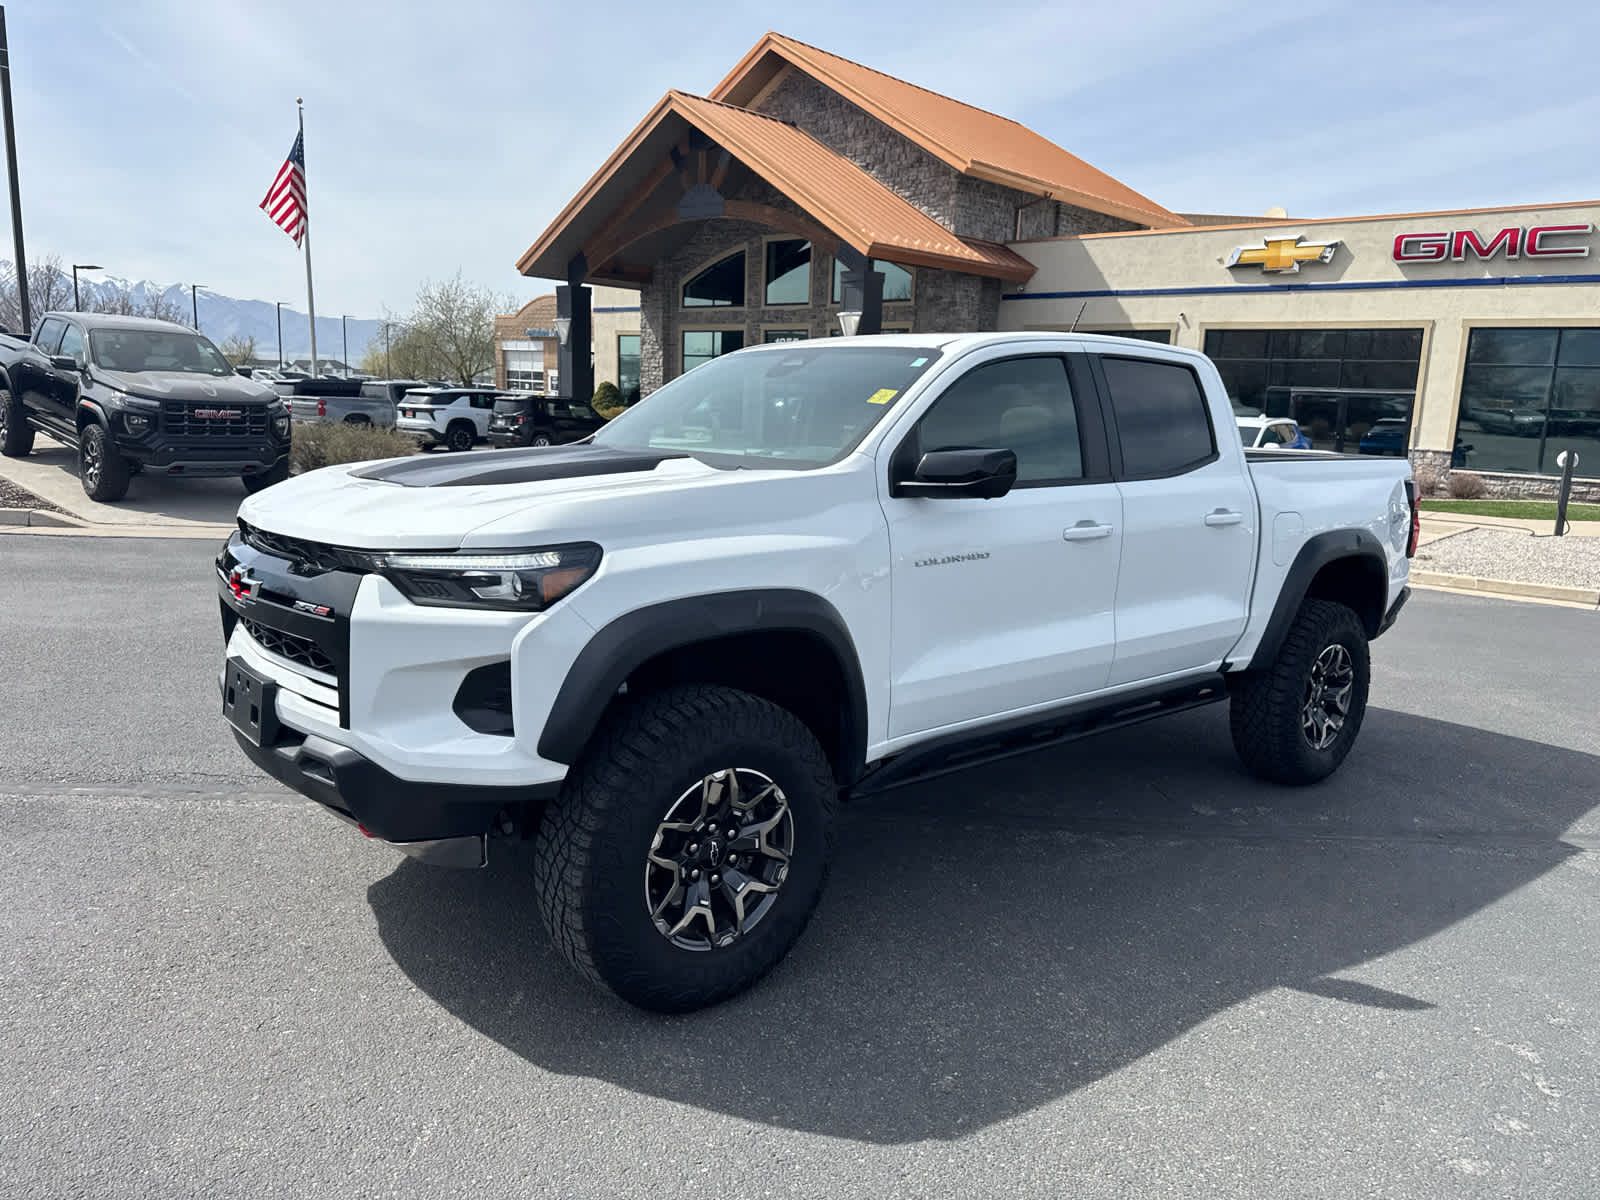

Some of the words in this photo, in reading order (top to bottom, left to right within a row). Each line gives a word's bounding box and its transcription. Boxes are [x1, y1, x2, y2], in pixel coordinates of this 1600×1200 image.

[1392, 224, 1593, 263] GMC
[194, 409, 242, 419] GMC
[914, 552, 991, 568] COLORADO
